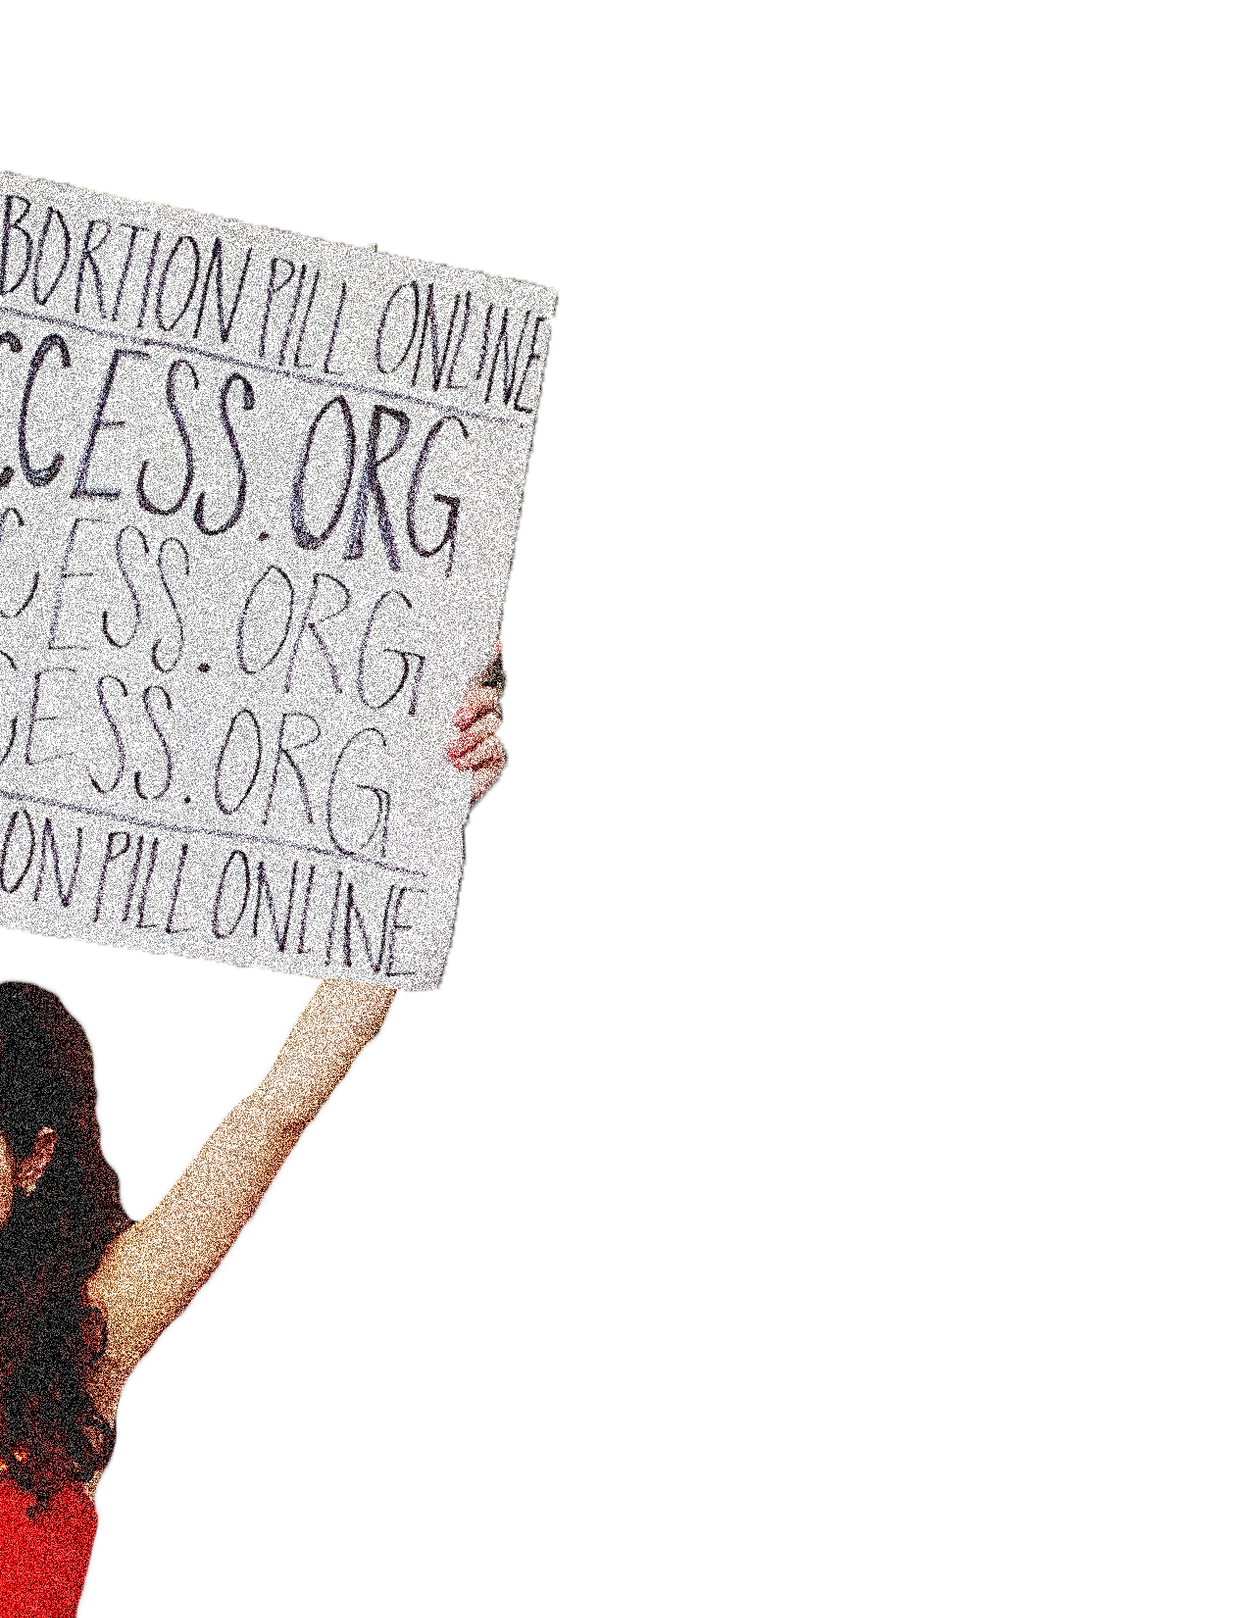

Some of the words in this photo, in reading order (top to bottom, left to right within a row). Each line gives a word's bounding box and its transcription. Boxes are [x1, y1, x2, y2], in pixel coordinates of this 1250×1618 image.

[258, 256, 348, 376] PILL
[373, 280, 548, 415] ONLINE
[91, 830, 193, 936] PILL
[210, 849, 428, 978] ONLINE
